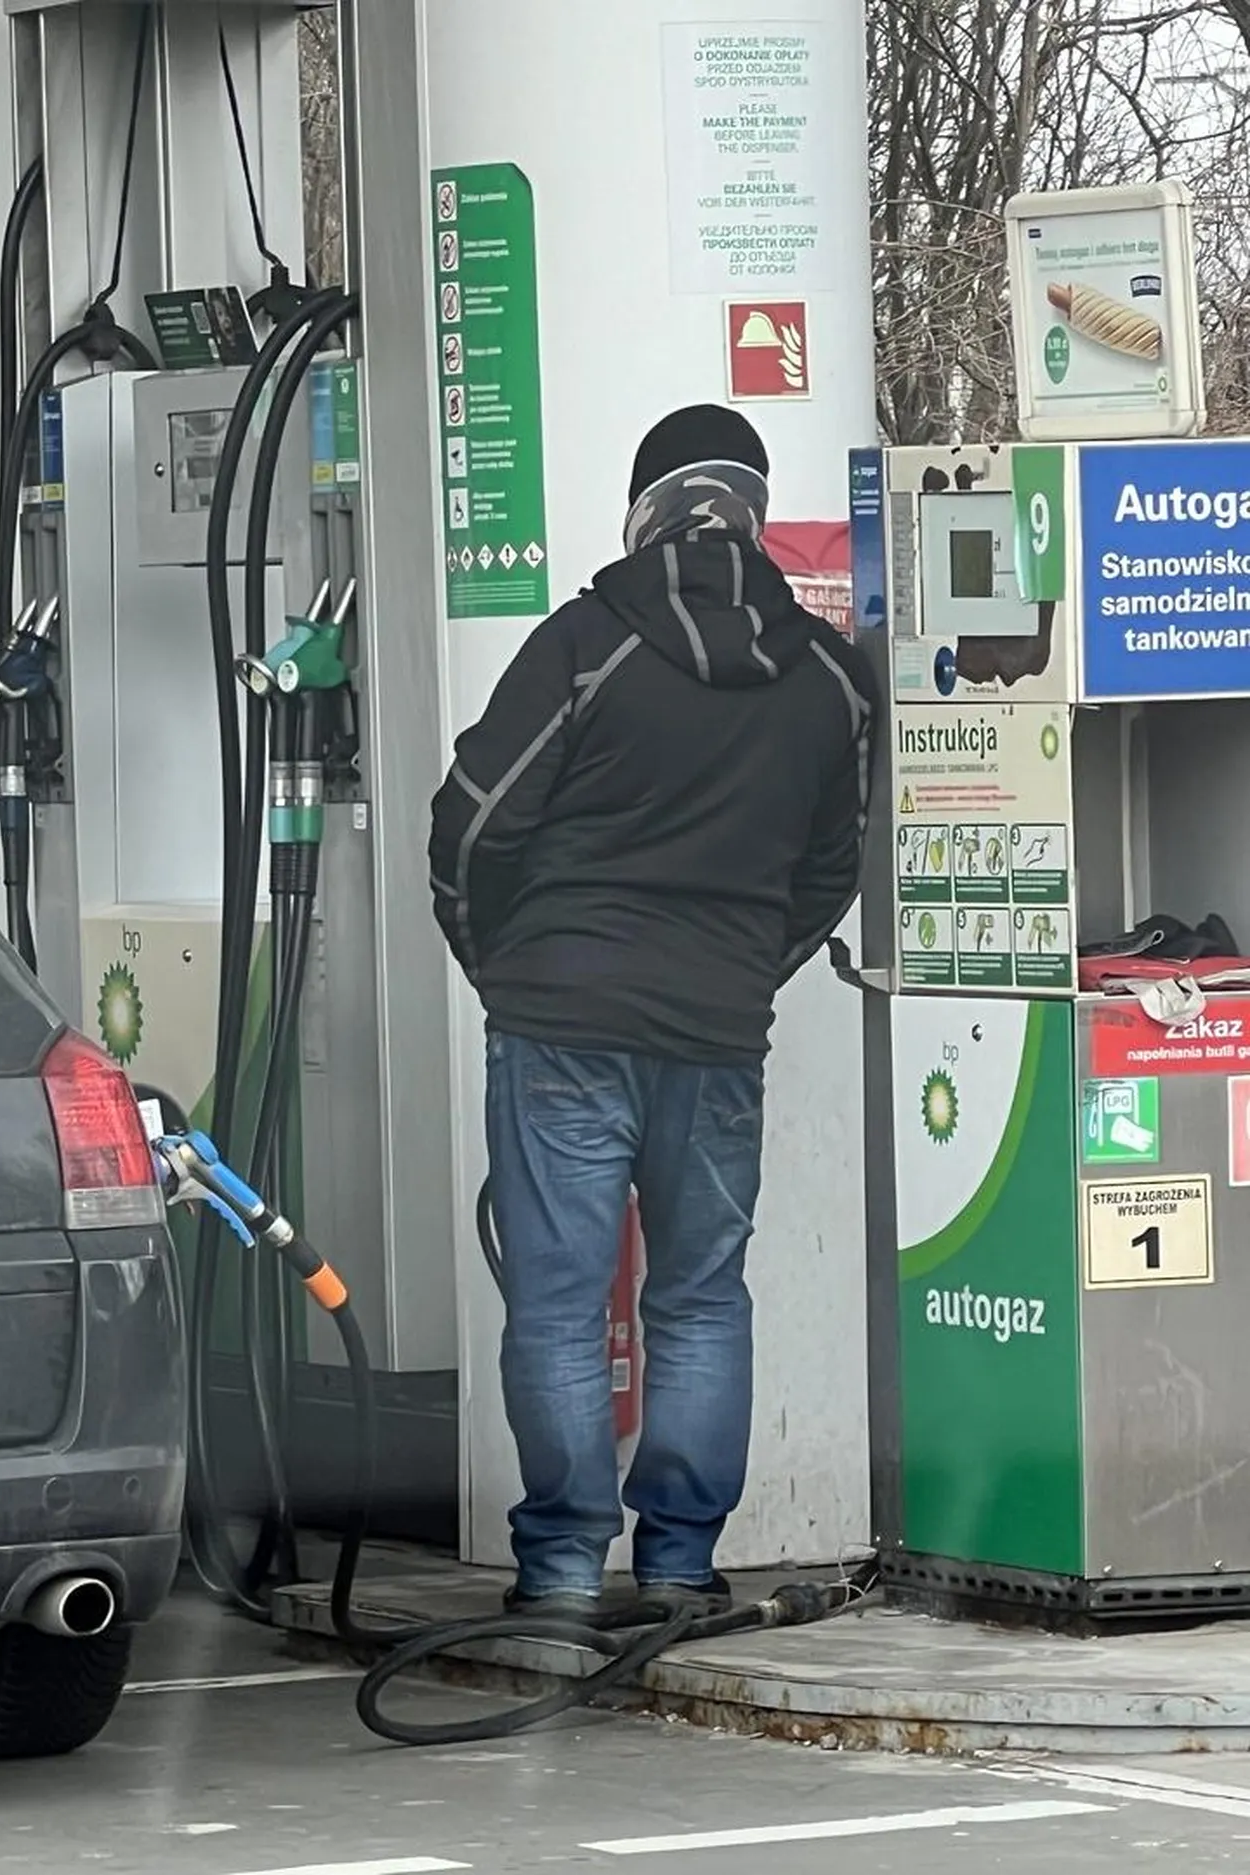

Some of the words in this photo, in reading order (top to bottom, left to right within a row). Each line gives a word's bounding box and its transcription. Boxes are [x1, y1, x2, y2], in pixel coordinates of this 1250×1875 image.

[693, 51, 703, 61] O
[706, 50, 771, 61] DOKONANIE
[707, 63, 743, 74] PRZED
[738, 103, 777, 115] PLEASE
[702, 117, 737, 128] MAKE
[739, 117, 760, 128] THE
[763, 116, 807, 128] PAYMENT
[714, 129, 756, 141] BEFORE
[717, 142, 739, 153] THE
[723, 183, 780, 194] BEZAHLEN
[697, 197, 722, 208] VOR
[724, 197, 747, 207] DER
[702, 238, 777, 250] ПРОИЗВЕСТИ
[729, 251, 746, 263] ДО
[729, 264, 744, 276] ОТ
[1030, 493, 1049, 556] 9
[899, 718, 997, 759] Instrukcja
[122, 923, 141, 958] bp
[943, 1042, 959, 1064] bp
[1107, 1095, 1130, 1108] LPG
[1093, 1192, 1131, 1205] STREFA
[1118, 1203, 1177, 1217] WYBUCHEM
[1131, 1226, 1160, 1269] 1
[926, 1284, 1045, 1343] autogaz
